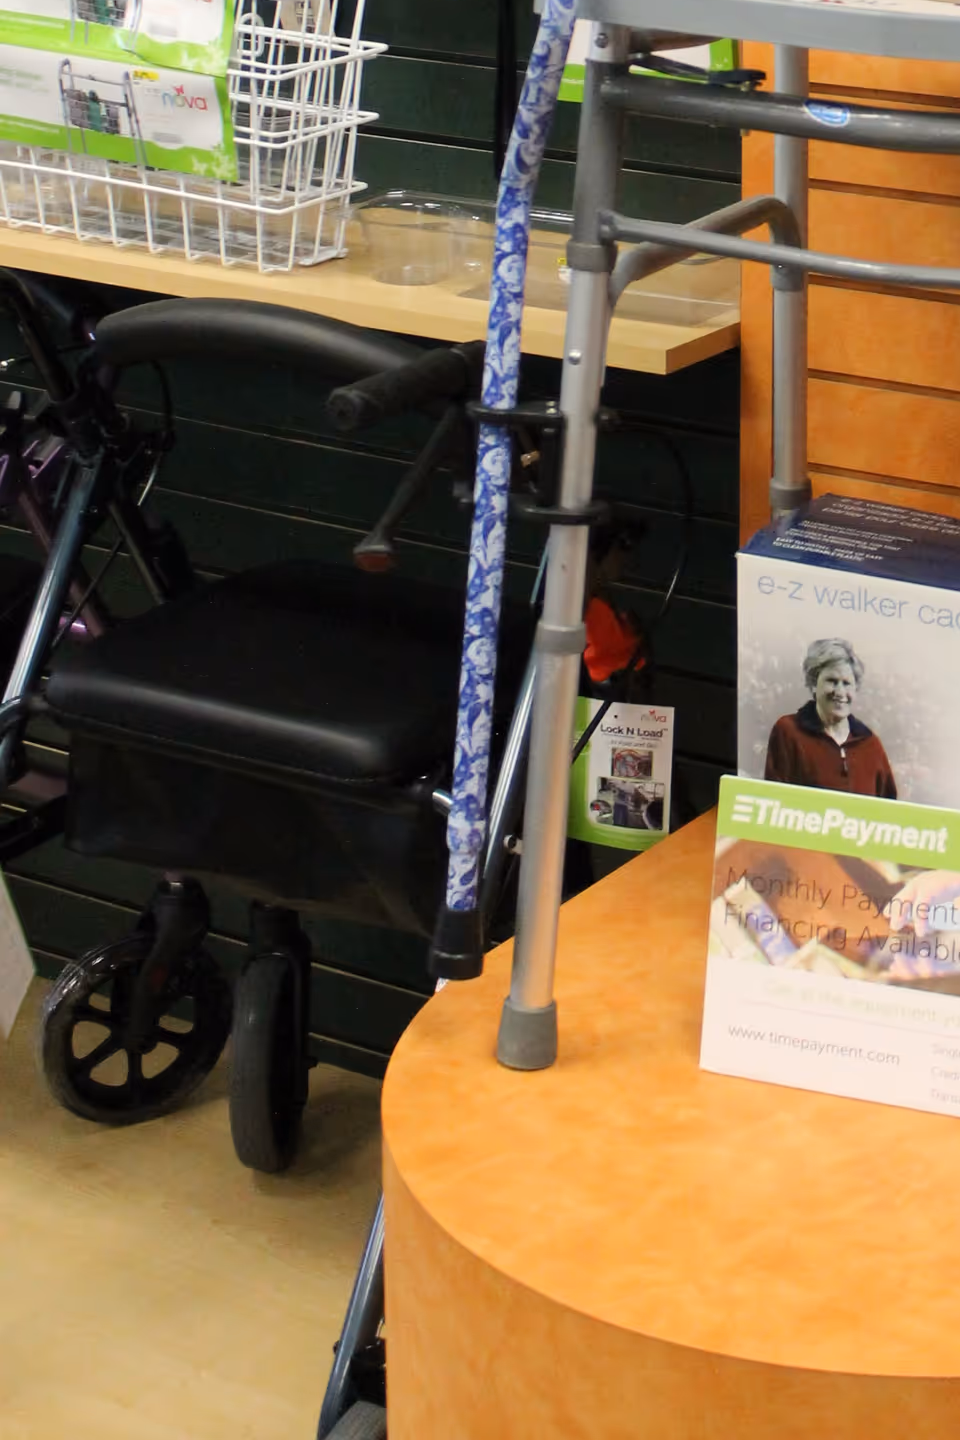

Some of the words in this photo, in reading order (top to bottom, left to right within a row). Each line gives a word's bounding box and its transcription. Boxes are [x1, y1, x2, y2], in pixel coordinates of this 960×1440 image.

[162, 90, 208, 111] nova
[758, 575, 804, 601] e-z
[814, 584, 910, 619] walker
[600, 725, 624, 735] Lock
[626, 727, 635, 735] N
[754, 795, 948, 854] TimePayment
[727, 867, 832, 909] Monthly
[843, 884, 959, 926] Payment
[724, 903, 846, 951] Financing
[728, 1023, 901, 1067] www.timepayment.com
